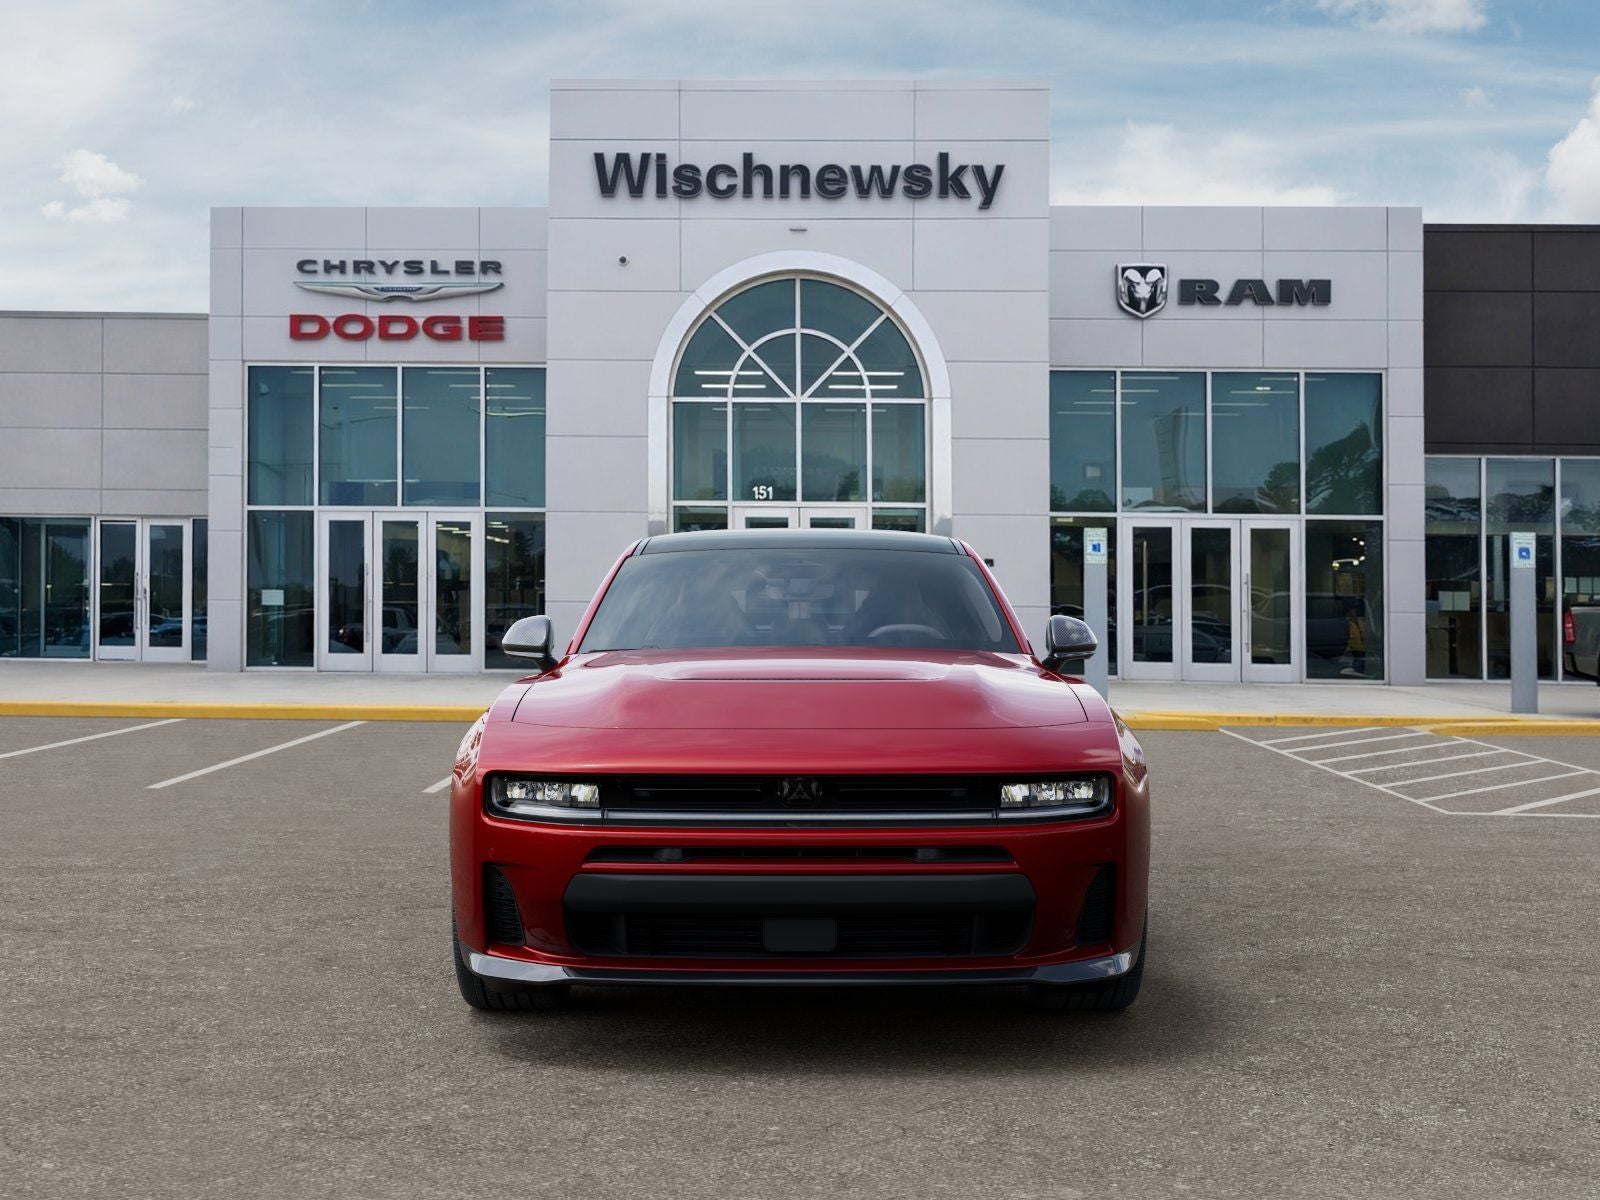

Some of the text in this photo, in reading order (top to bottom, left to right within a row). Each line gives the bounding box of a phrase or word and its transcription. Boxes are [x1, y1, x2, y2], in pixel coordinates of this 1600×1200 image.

[593, 152, 1006, 210] Wischnewsky
[296, 259, 503, 275] CHRYSLER
[1177, 278, 1332, 306] RAM
[289, 313, 505, 342] DODGE
[752, 485, 773, 500] 151
